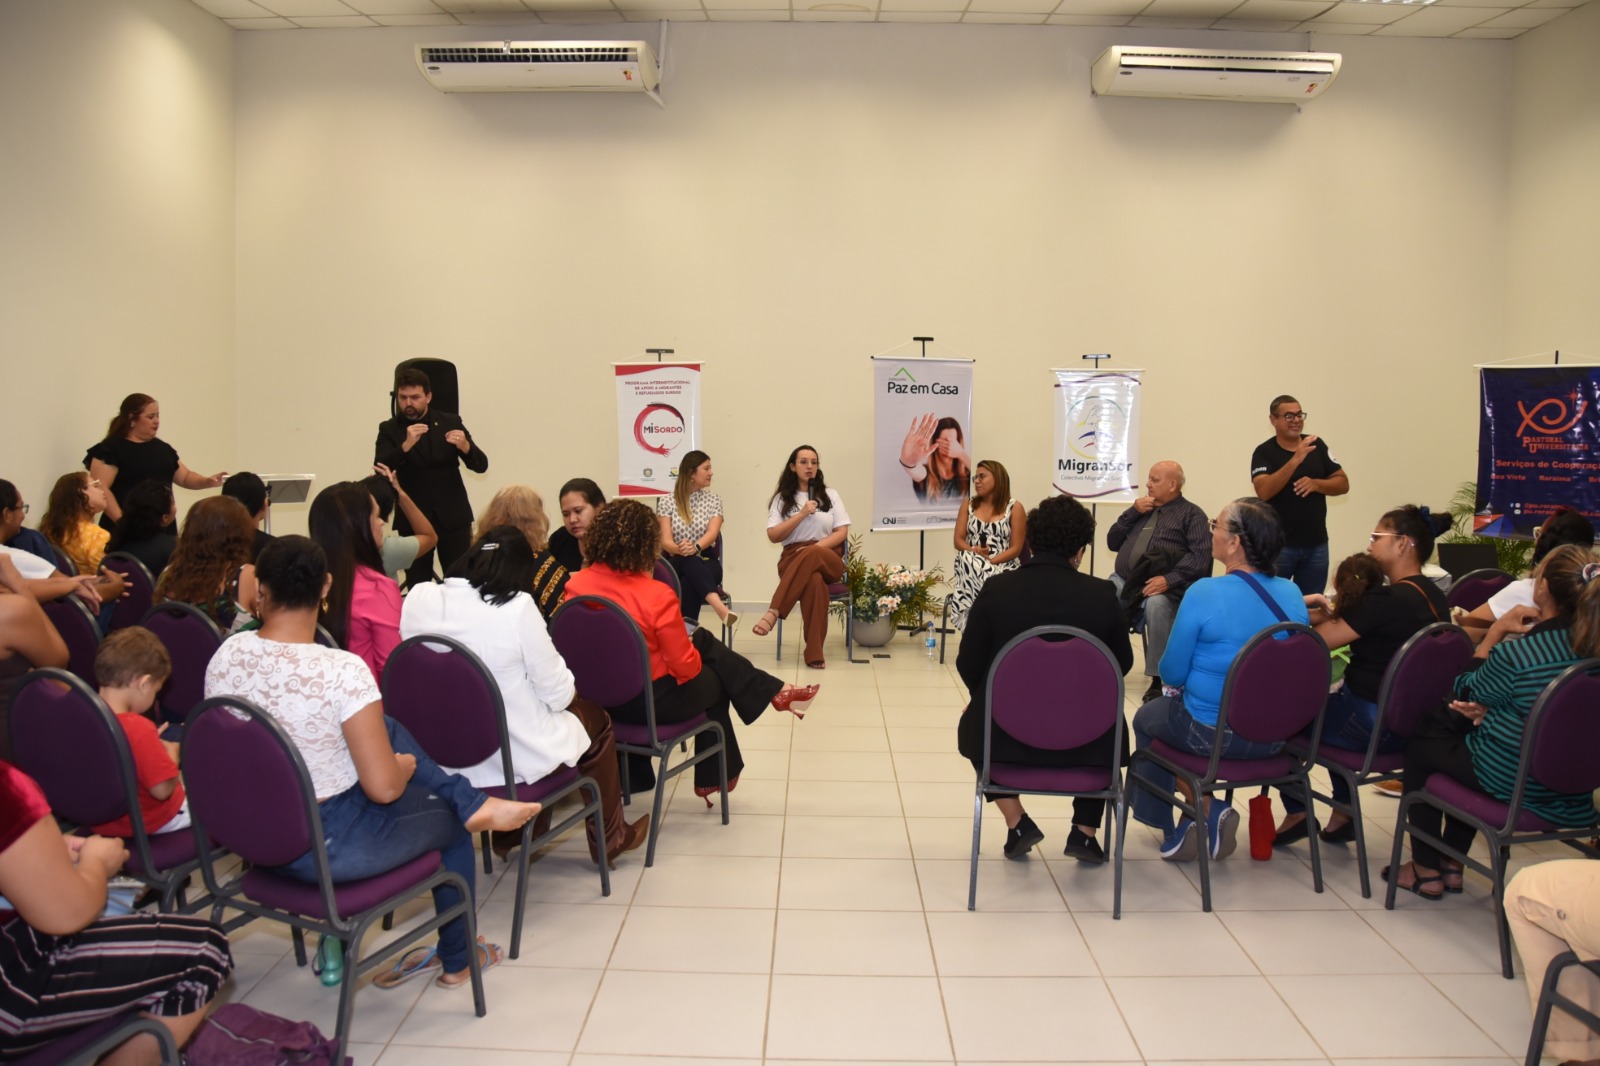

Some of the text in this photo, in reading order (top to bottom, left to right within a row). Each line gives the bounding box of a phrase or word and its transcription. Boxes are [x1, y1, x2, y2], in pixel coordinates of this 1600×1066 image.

[888, 382, 958, 394] Paz em Casa
[1522, 437, 1564, 447] PASTORAL
[1058, 459, 1132, 474] MigranSor
[1496, 460, 1535, 469] Serviços
